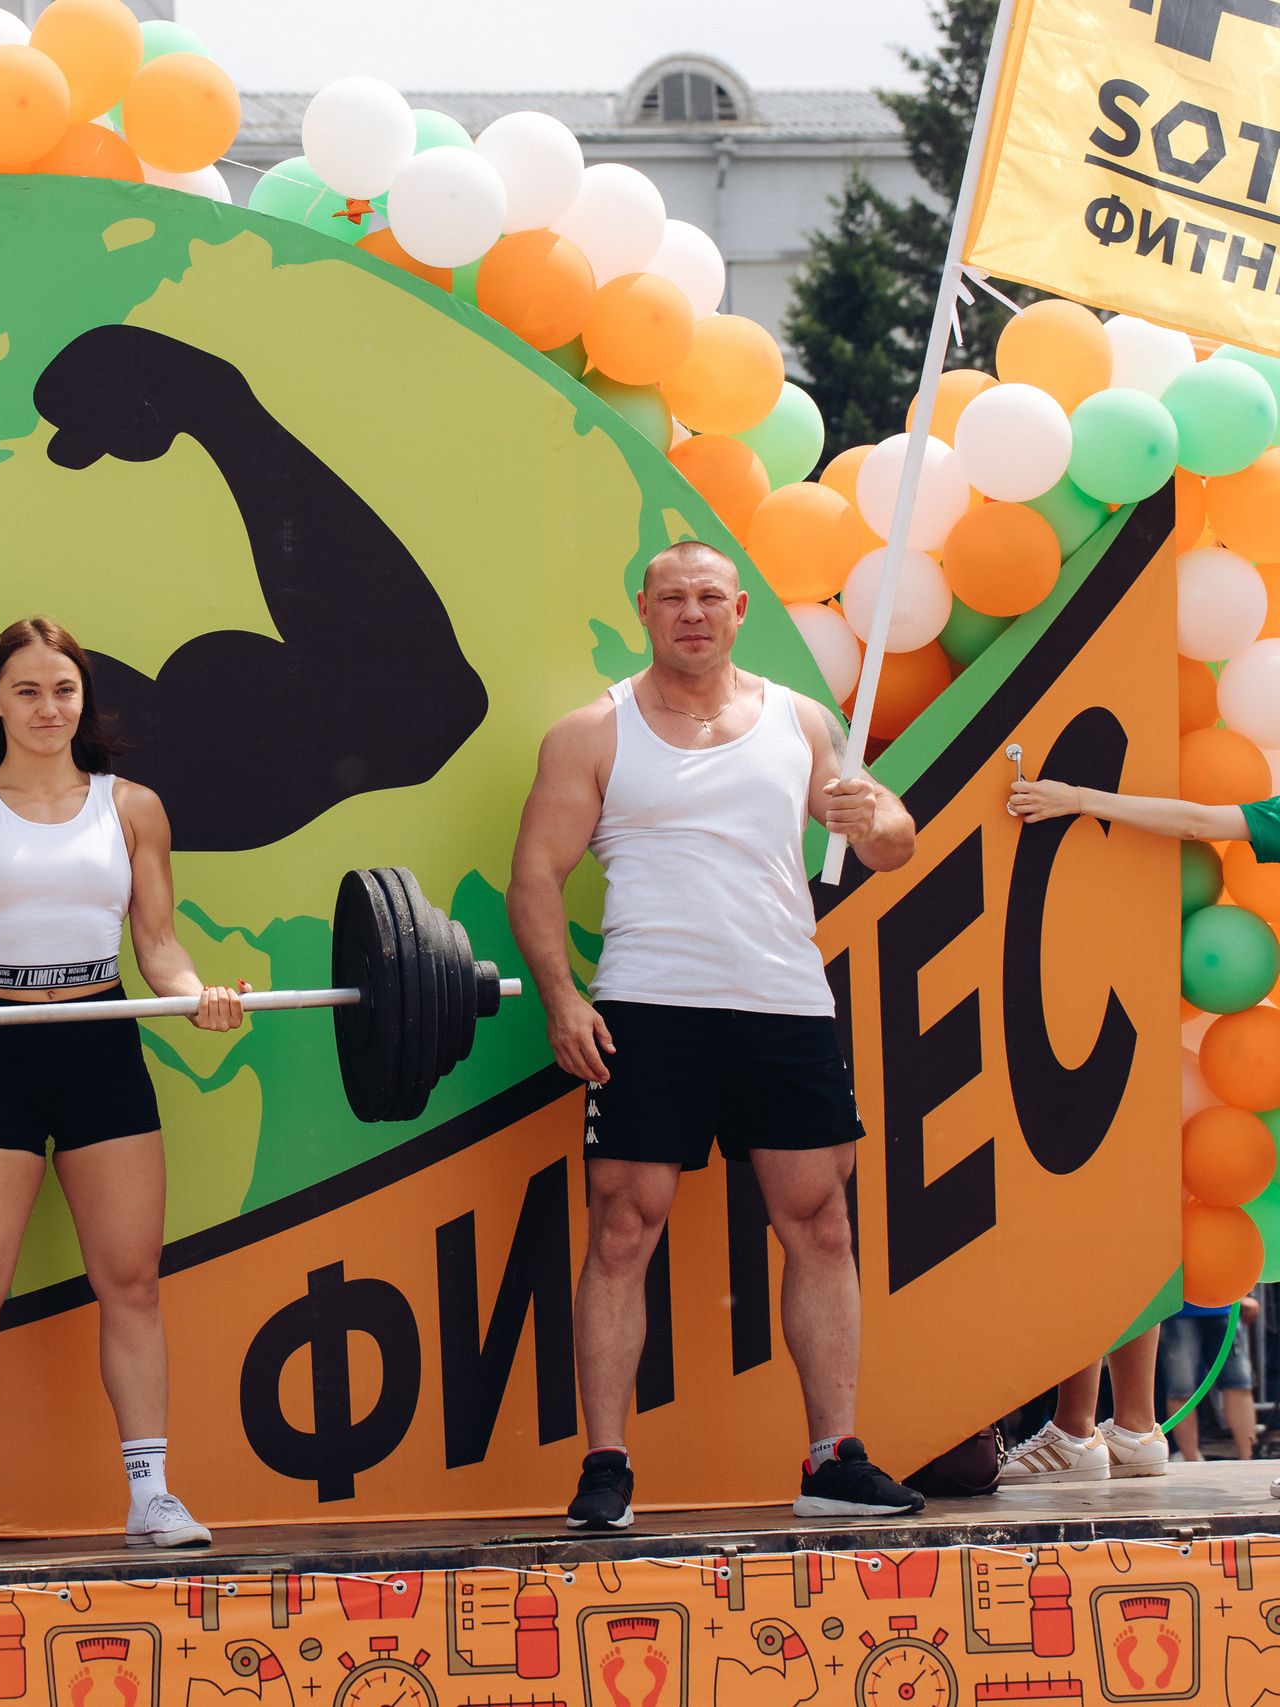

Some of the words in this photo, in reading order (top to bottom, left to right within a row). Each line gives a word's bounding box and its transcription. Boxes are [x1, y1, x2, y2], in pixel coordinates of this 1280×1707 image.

[1084, 194, 1280, 296] ФИТН
[27, 967, 67, 986] LIMITS
[68, 966, 88, 975] MOVING
[67, 974, 90, 983] FORWARD
